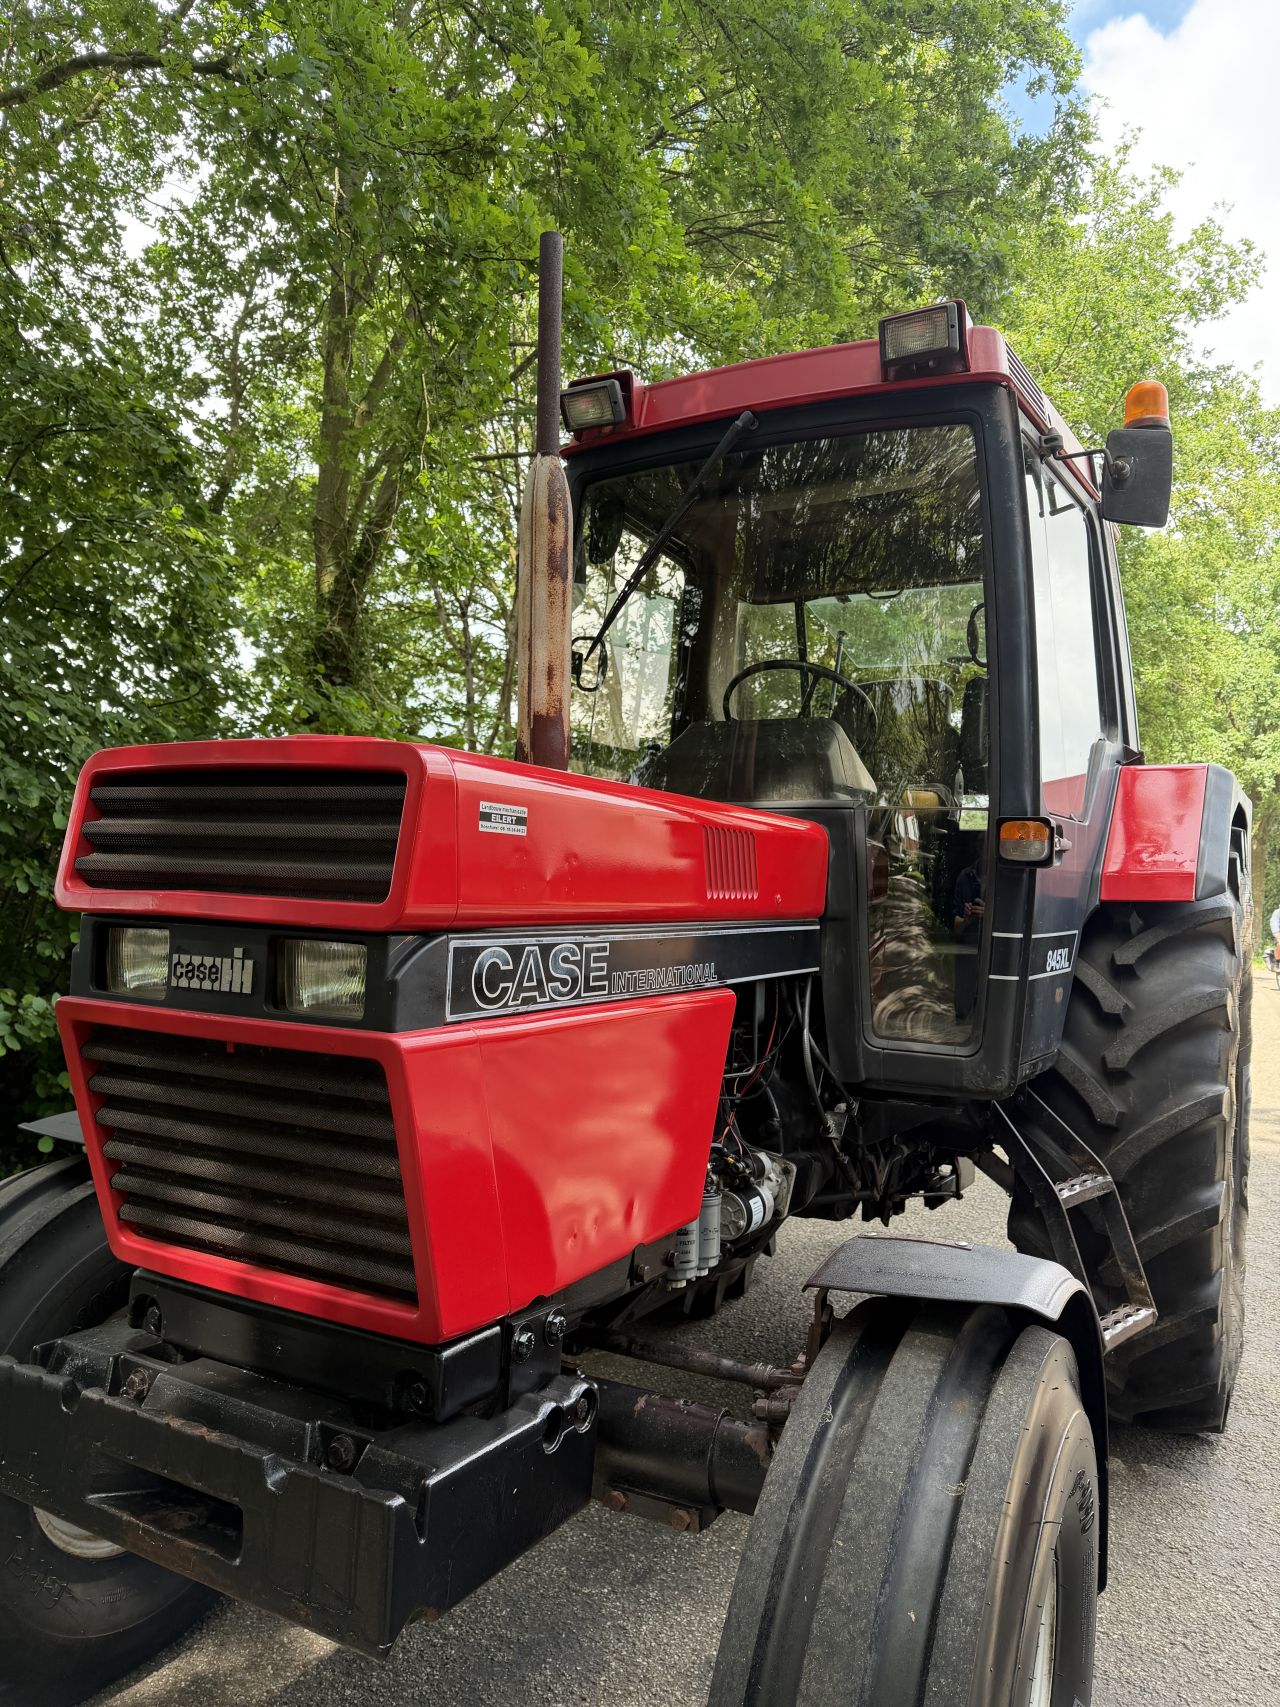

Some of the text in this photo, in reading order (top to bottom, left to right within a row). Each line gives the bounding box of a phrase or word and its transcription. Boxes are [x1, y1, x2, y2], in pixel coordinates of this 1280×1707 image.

[492, 814, 516, 824] EILERT
[1046, 947, 1070, 972] 845XL
[472, 943, 718, 1009] CASE INTERNATIONAL
